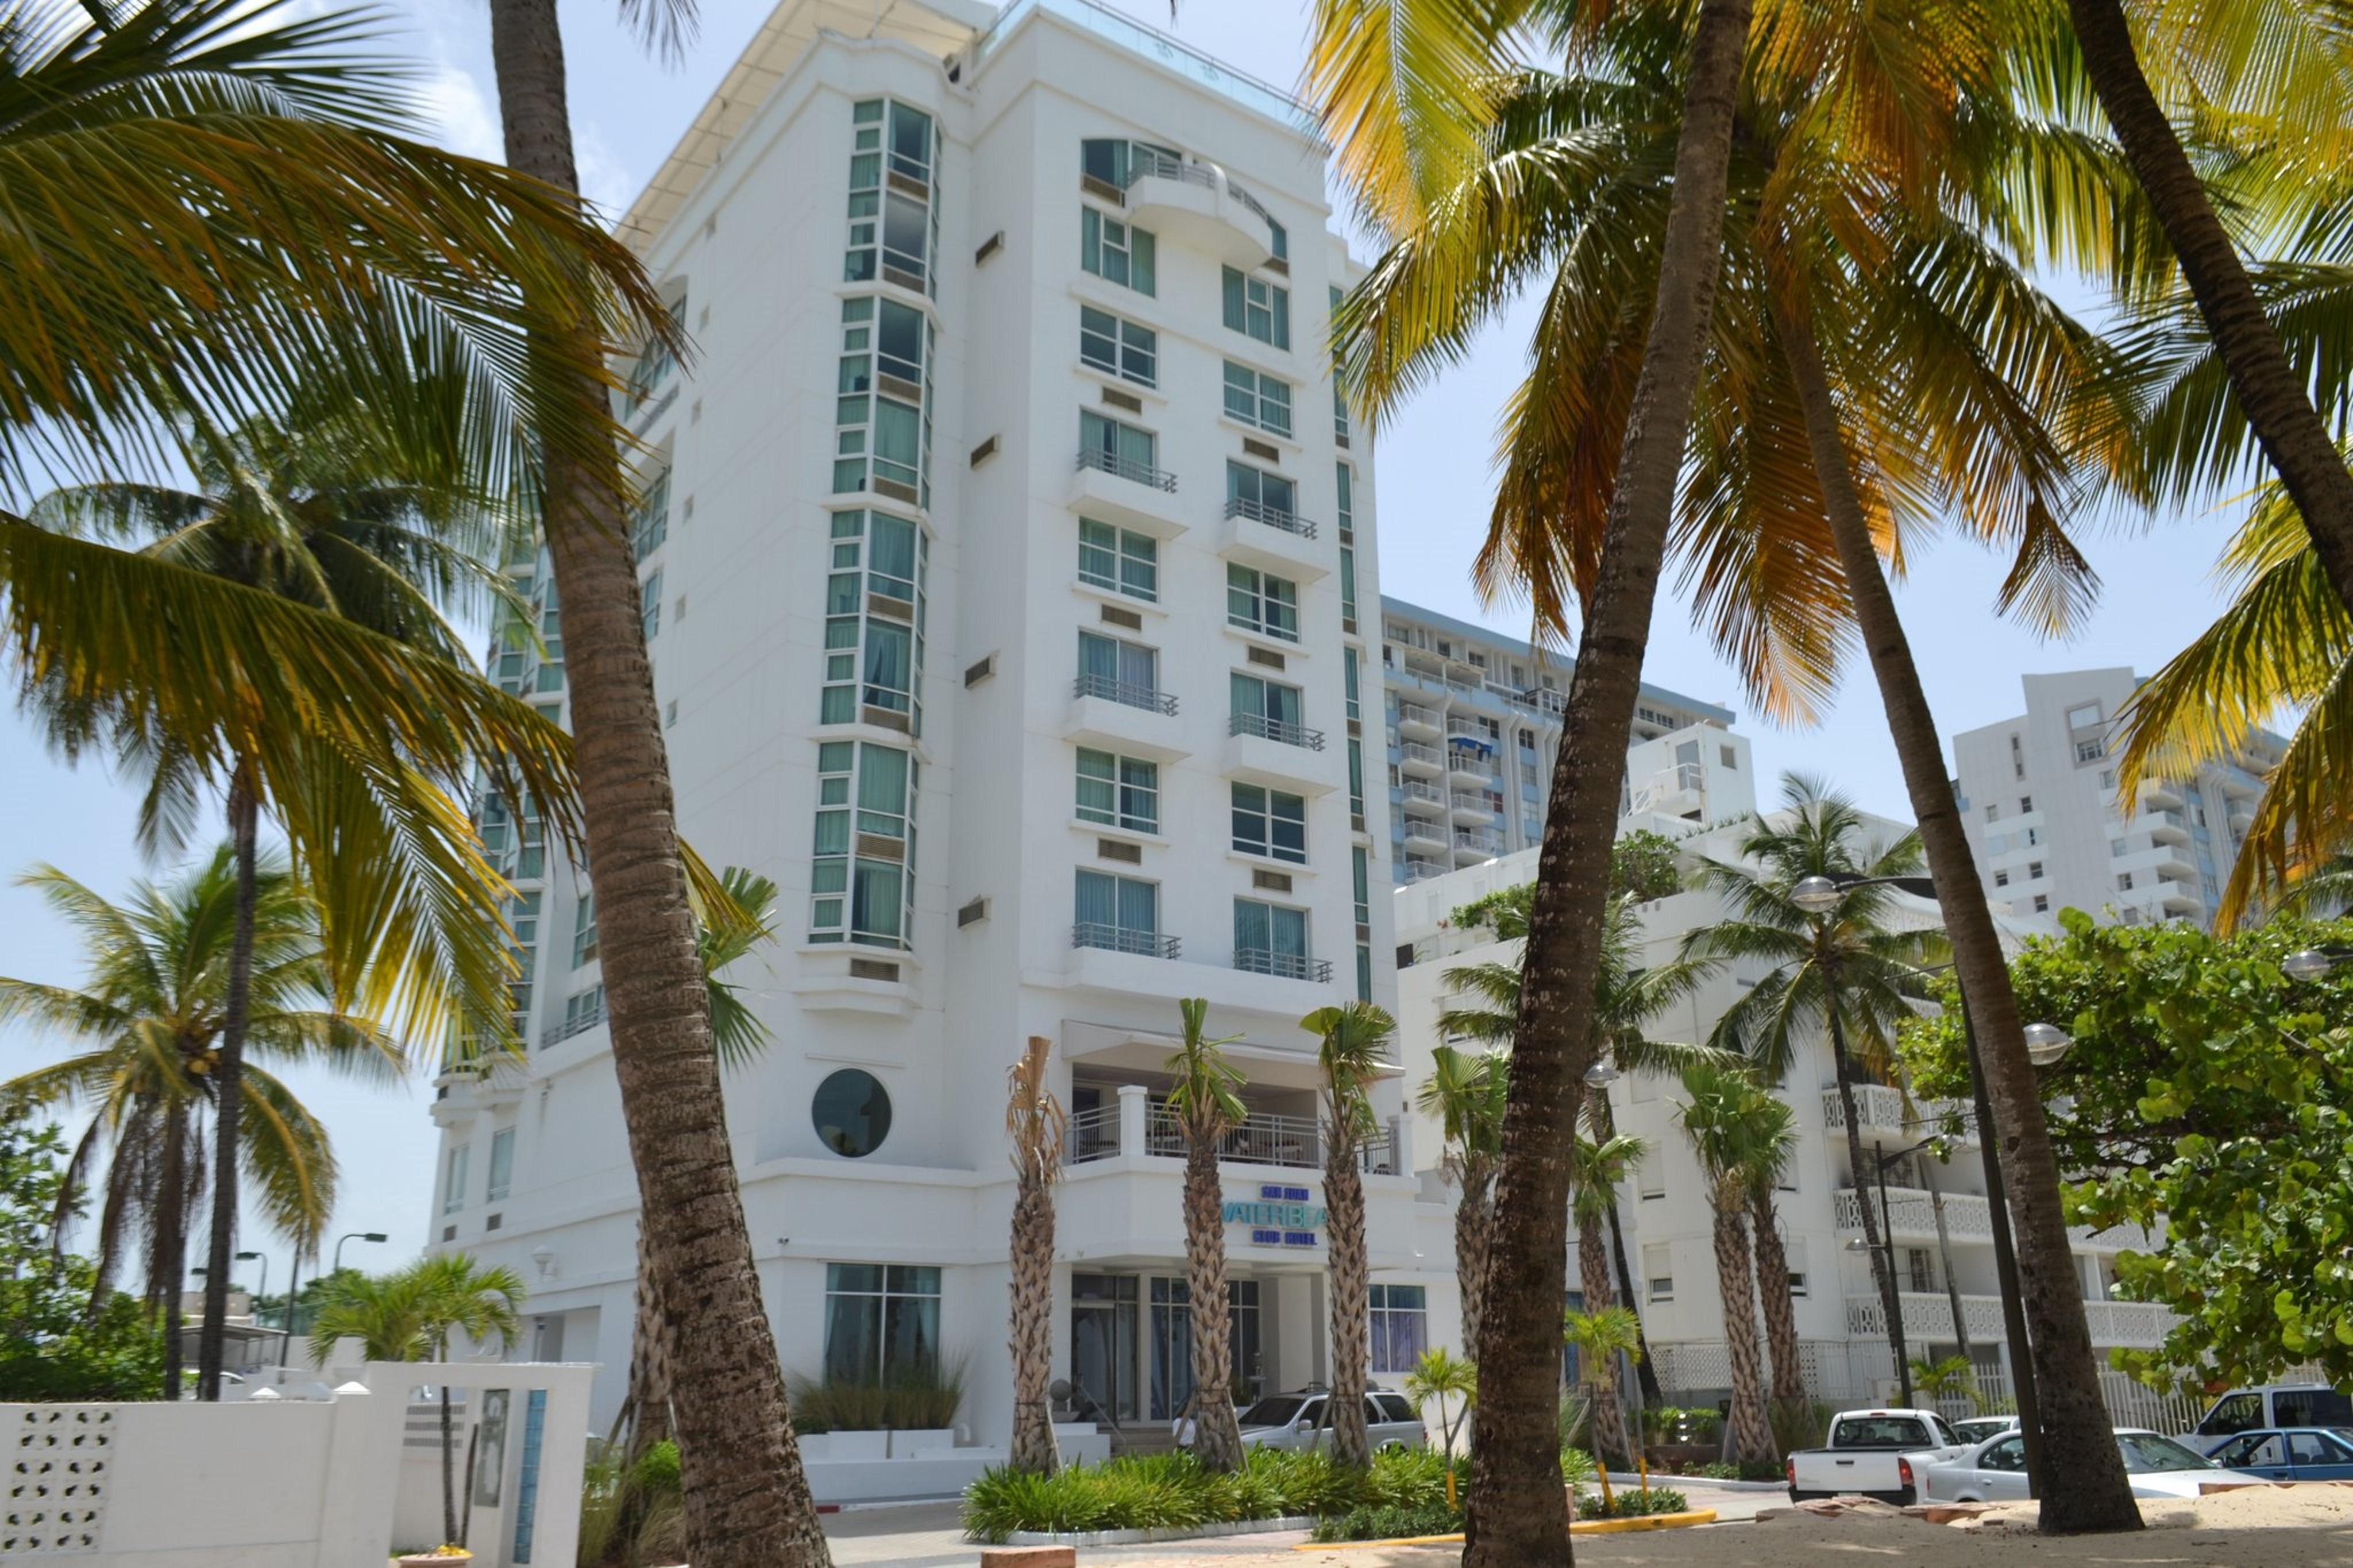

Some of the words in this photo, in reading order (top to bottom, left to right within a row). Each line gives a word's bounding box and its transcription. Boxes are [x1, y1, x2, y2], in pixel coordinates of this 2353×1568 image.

[1261, 1185, 1282, 1199] SAN
[1284, 1188, 1309, 1201] JUAN
[1252, 1230, 1280, 1243] CLUB
[1284, 1232, 1317, 1245] HOTEL
